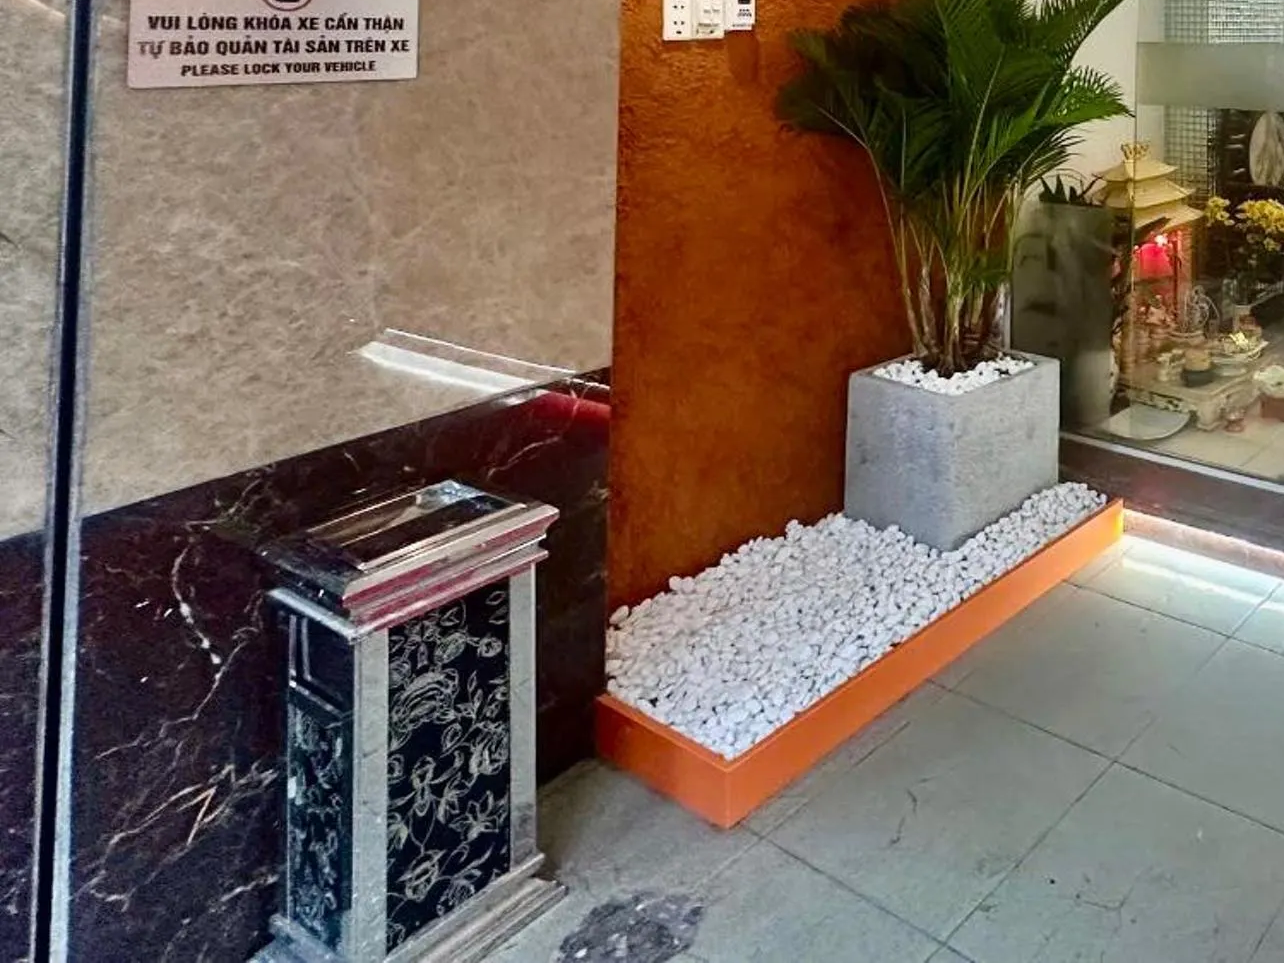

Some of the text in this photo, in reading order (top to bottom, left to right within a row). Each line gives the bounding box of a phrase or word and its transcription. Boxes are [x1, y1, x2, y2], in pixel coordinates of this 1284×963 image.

[147, 15, 181, 31] VUI
[297, 17, 320, 31] XE
[390, 39, 410, 53] XE
[180, 60, 376, 77] PLEASE LOCK YOUR VEHICLE
